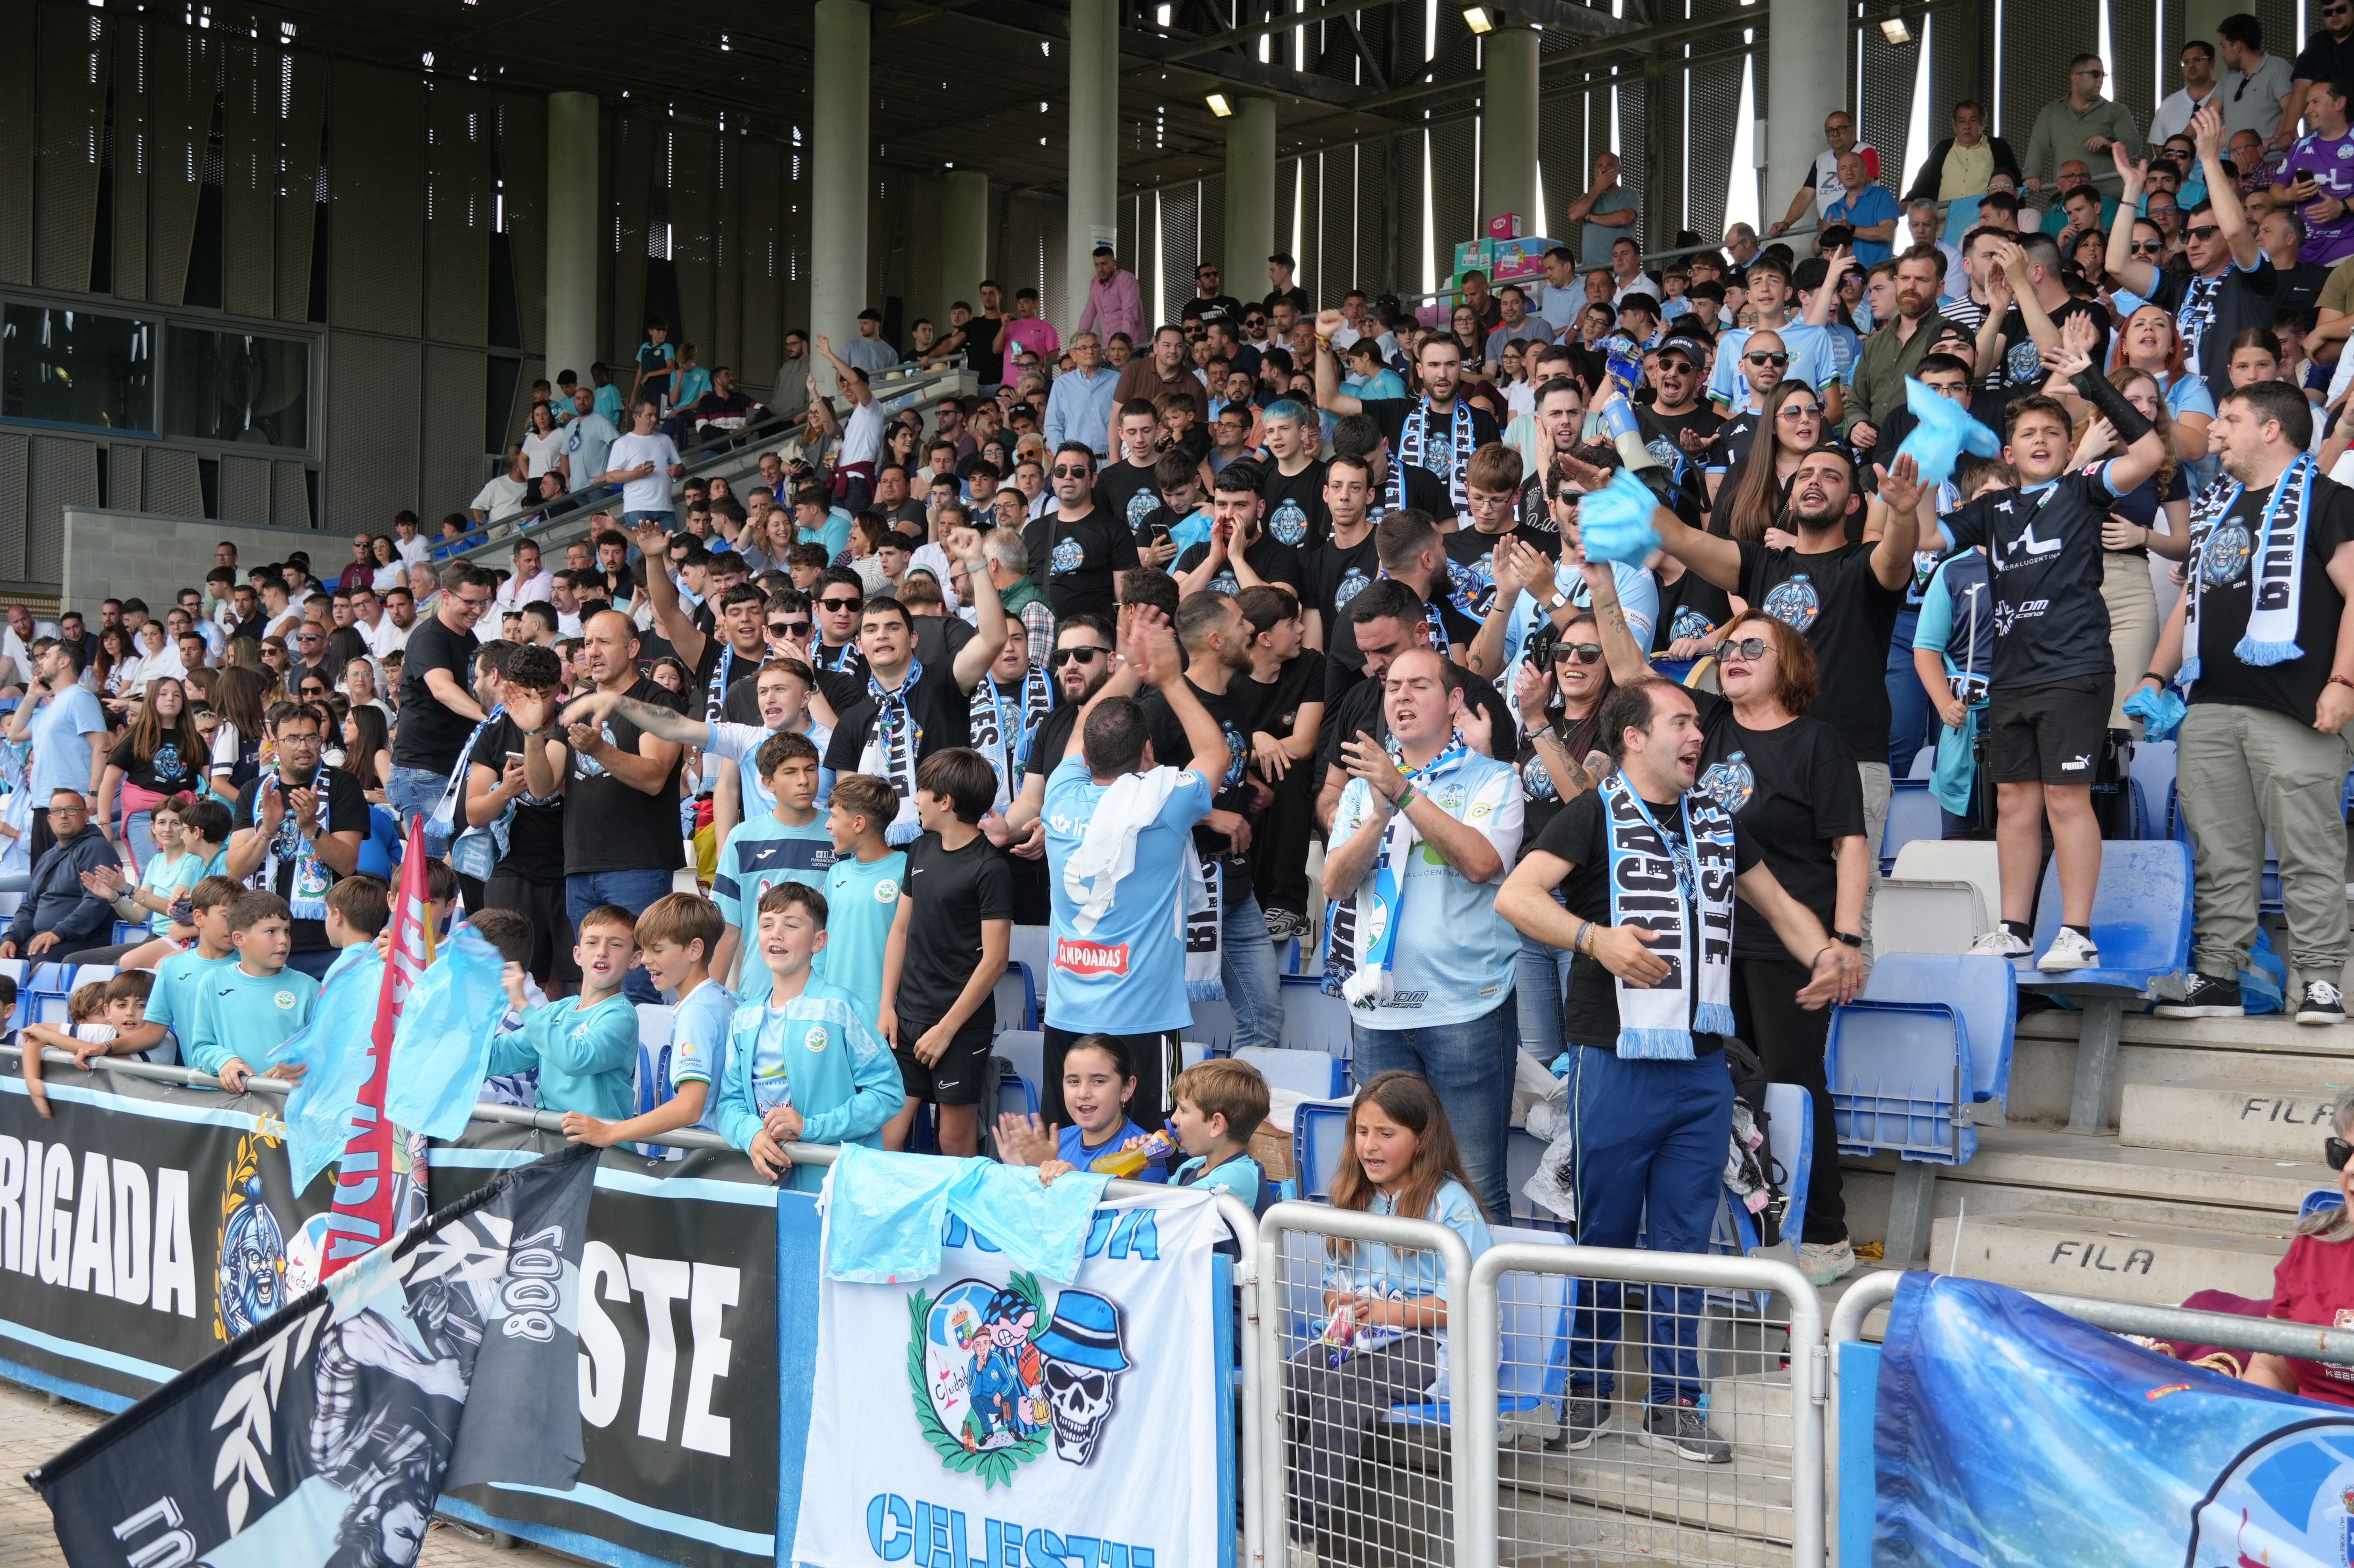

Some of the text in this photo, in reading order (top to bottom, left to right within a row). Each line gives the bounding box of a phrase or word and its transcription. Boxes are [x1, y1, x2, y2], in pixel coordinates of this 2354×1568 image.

[1669, 339, 1692, 349] SILBON
[2233, 581, 2247, 589] 2024
[2062, 761, 2085, 771] PUMA
[1413, 869, 1460, 878] LUCENTINA
[1059, 943, 1121, 968] CAMPOARAS
[1378, 1000, 1422, 1008] Lucena
[2050, 1241, 2154, 1275] FILA
